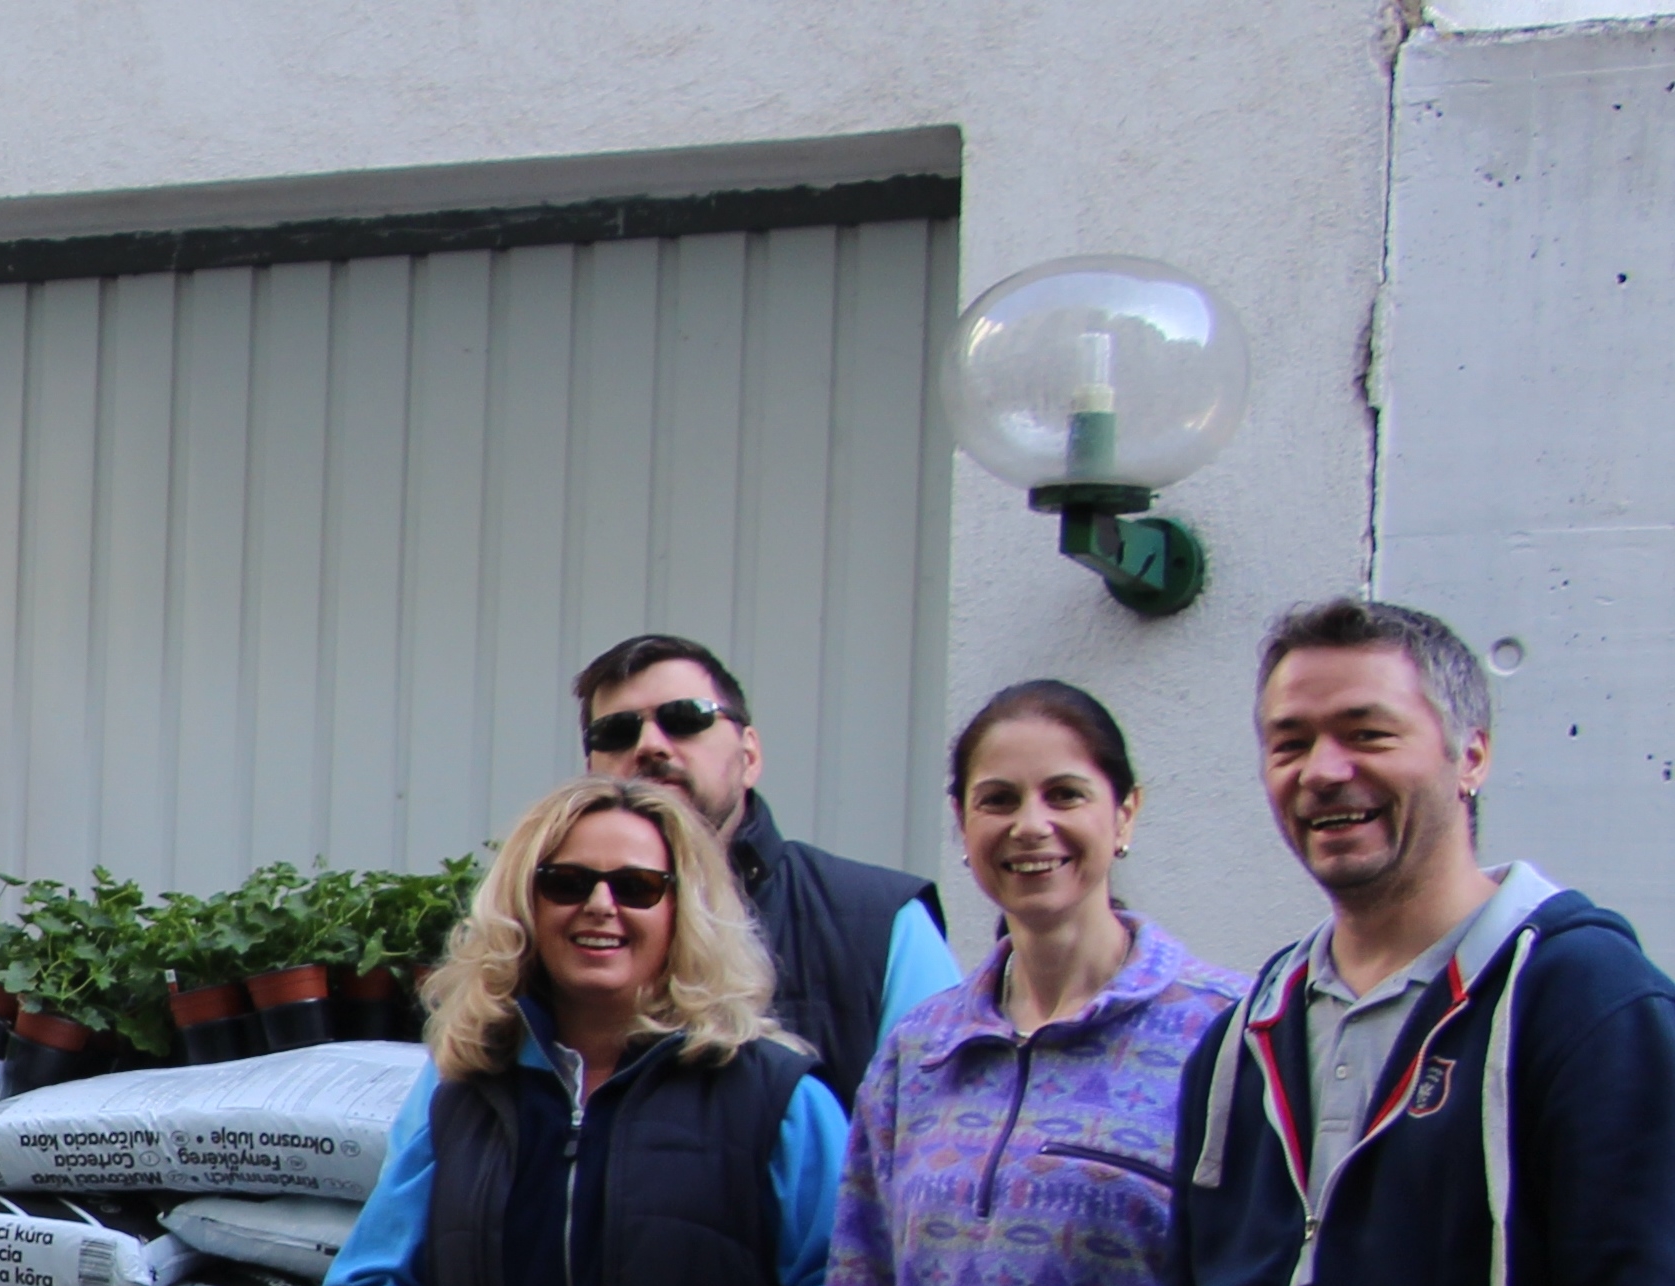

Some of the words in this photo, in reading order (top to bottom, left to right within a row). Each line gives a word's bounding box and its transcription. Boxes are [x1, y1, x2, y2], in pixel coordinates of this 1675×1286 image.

[211, 1127, 255, 1149] lubje
[260, 1133, 335, 1155] Okrasno
[54, 1153, 135, 1171] Corteccia
